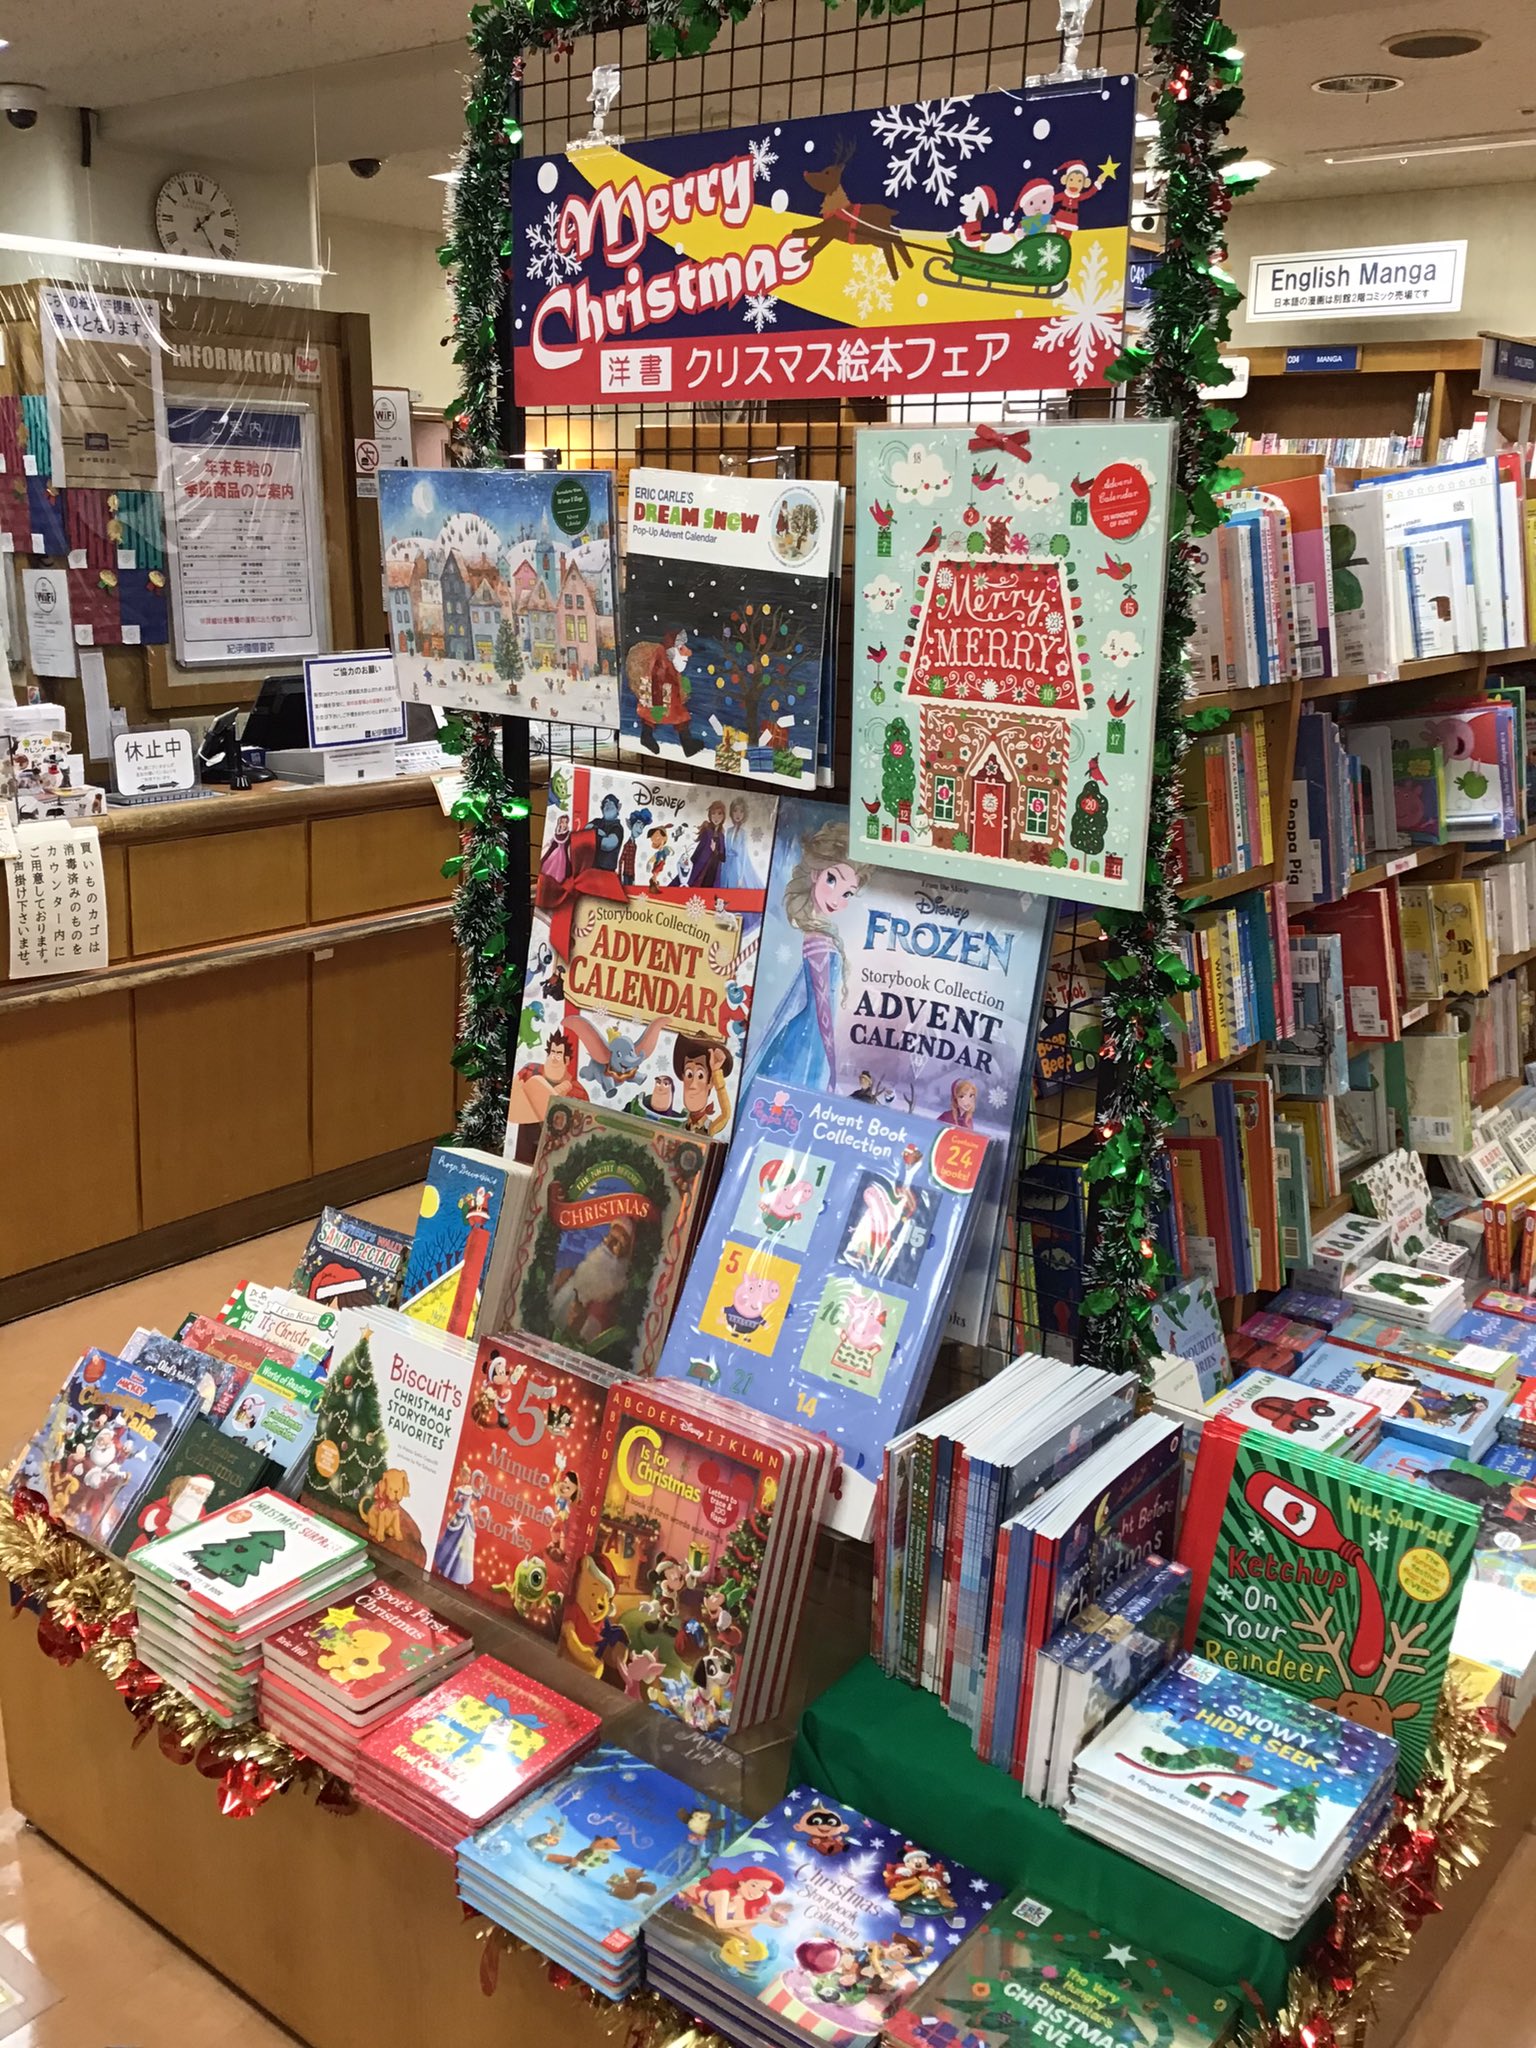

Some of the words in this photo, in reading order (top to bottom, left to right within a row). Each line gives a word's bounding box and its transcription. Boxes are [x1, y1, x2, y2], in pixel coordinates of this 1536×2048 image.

[560, 156, 756, 267] Merry
[1271, 264, 1350, 293] English
[1360, 262, 1437, 287] Manga
[531, 235, 814, 370] Christmas
[172, 343, 294, 376] INFORMATION
[606, 353, 666, 387] 洋書
[685, 332, 1012, 388] クリスマス絵本フェア
[1316, 354, 1343, 365] MANGA
[375, 410, 395, 421] WiFi
[204, 459, 273, 478] 年末年始の
[634, 486, 656, 501] ERIC
[657, 488, 694, 504] CARLE'S
[1098, 488, 1139, 504] Calendar
[633, 502, 699, 528] DREAM
[703, 507, 761, 535] SNOW
[633, 524, 658, 540] Pop-Up
[659, 528, 685, 541] Advent
[684, 530, 718, 545] Calendar
[937, 574, 1050, 627] Merry
[933, 626, 1064, 675] MERRY
[333, 665, 381, 677] ご協力のお願い
[125, 737, 182, 763] 休止中
[631, 781, 686, 818] Disney
[1232, 776, 1240, 801] GREEN
[1286, 798, 1299, 853] Peppa
[1286, 859, 1302, 885] Pig
[30, 846, 48, 964] ご用意しております。
[47, 845, 65, 957] カウンター内に
[63, 843, 82, 956] 消毒済みのものを
[80, 841, 100, 954] 買いものカゴは
[914, 890, 970, 926] Disney
[596, 907, 654, 925] Storybook
[655, 911, 711, 944] Collection
[862, 908, 1016, 977] FROZEN
[589, 924, 704, 980] ADVENT
[568, 954, 718, 1028] CALENDAR
[860, 967, 931, 991] Storybook
[933, 978, 1006, 1012] Collection
[1215, 958, 1224, 991] Who
[853, 990, 1004, 1046] ADVENT
[1217, 992, 1226, 1014] Am
[850, 1023, 993, 1075] CALENDAR
[1040, 1051, 1073, 1080] Beep
[754, 1099, 782, 1127] Peppa
[783, 1107, 799, 1134] Pig
[808, 1102, 865, 1132] Advent
[867, 1117, 908, 1145] Book
[812, 1121, 893, 1160] Collection
[939, 1165, 971, 1183] books!
[945, 1146, 973, 1170] 24
[576, 1176, 589, 1192] THE
[590, 1163, 615, 1178] NIGHT
[616, 1165, 641, 1187] BEFORE
[815, 1164, 827, 1188] 1
[559, 1198, 650, 1227] CHRISTMAS
[318, 1222, 352, 1252] SANTA
[725, 1249, 743, 1275] 5
[258, 1314, 276, 1333] It's
[280, 1306, 296, 1318] Can
[322, 1315, 330, 1325] 3
[157, 1359, 178, 1378] Olaf's
[262, 1365, 280, 1382] World
[279, 1374, 288, 1386] of
[286, 1375, 313, 1398] Reading
[390, 1353, 463, 1408] Biscuit's
[729, 1369, 755, 1395] 21
[1261, 1375, 1277, 1391] CAR
[116, 1377, 148, 1397] MICKEY
[266, 1408, 303, 1434] Christmas
[387, 1399, 452, 1438] STORYBOOK
[394, 1387, 453, 1422] CHRISTMAS
[508, 1379, 557, 1447] 5
[796, 1392, 818, 1419] 14
[121, 1408, 158, 1441] Tales
[387, 1416, 445, 1451] FAVORITES
[679, 1418, 705, 1439] Disney
[185, 1443, 245, 1489] Christmas
[209, 1437, 240, 1465] Father
[486, 1441, 550, 1490] Minute
[616, 1425, 663, 1497] C
[640, 1444, 651, 1459] Is
[652, 1447, 670, 1468] for
[471, 1468, 556, 1528] Christmas
[636, 1461, 702, 1504] Christmas
[708, 1486, 730, 1502] Letters
[248, 1500, 301, 1532] CHRISTMAS
[710, 1497, 727, 1512] trace
[714, 1506, 726, 1517] 100
[1138, 1494, 1175, 1530] Before
[1346, 1495, 1381, 1522] Nick
[1385, 1508, 1457, 1548] Sharratt
[476, 1504, 533, 1552] Stories
[1227, 1545, 1348, 1596] Ketchup
[371, 1585, 414, 1613] Spot's
[410, 1608, 451, 1635] First
[1243, 1585, 1279, 1613] On
[354, 1594, 428, 1642] Christmas
[1220, 1612, 1288, 1644] Your
[275, 1635, 293, 1650] Eric
[291, 1641, 309, 1658] Hill
[1203, 1638, 1333, 1685] Reindeer
[1195, 1708, 1250, 1741] HIDE
[1249, 1732, 1262, 1745] &
[1263, 1738, 1325, 1772] SEEK
[1223, 1703, 1316, 1749] SNOWY
[392, 1744, 418, 1767] Rod
[1138, 1776, 1168, 1796] finger
[1169, 1791, 1190, 1804] trail
[1190, 1800, 1248, 1835] lift-the-flap
[1249, 1830, 1275, 1847] book
[586, 1811, 655, 1850] Fox
[794, 1862, 884, 1917] Christmas
[797, 1884, 859, 1925] Storybook
[803, 1903, 860, 1941] Collection
[1021, 1903, 1046, 1921] ERIC
[1062, 1980, 1107, 2011] Hungry
[1066, 1966, 1089, 1987] The
[1093, 1981, 1121, 2005] Very
[1039, 1981, 1115, 2030] Caterpillar's
[1031, 2019, 1074, 2048] EVE
